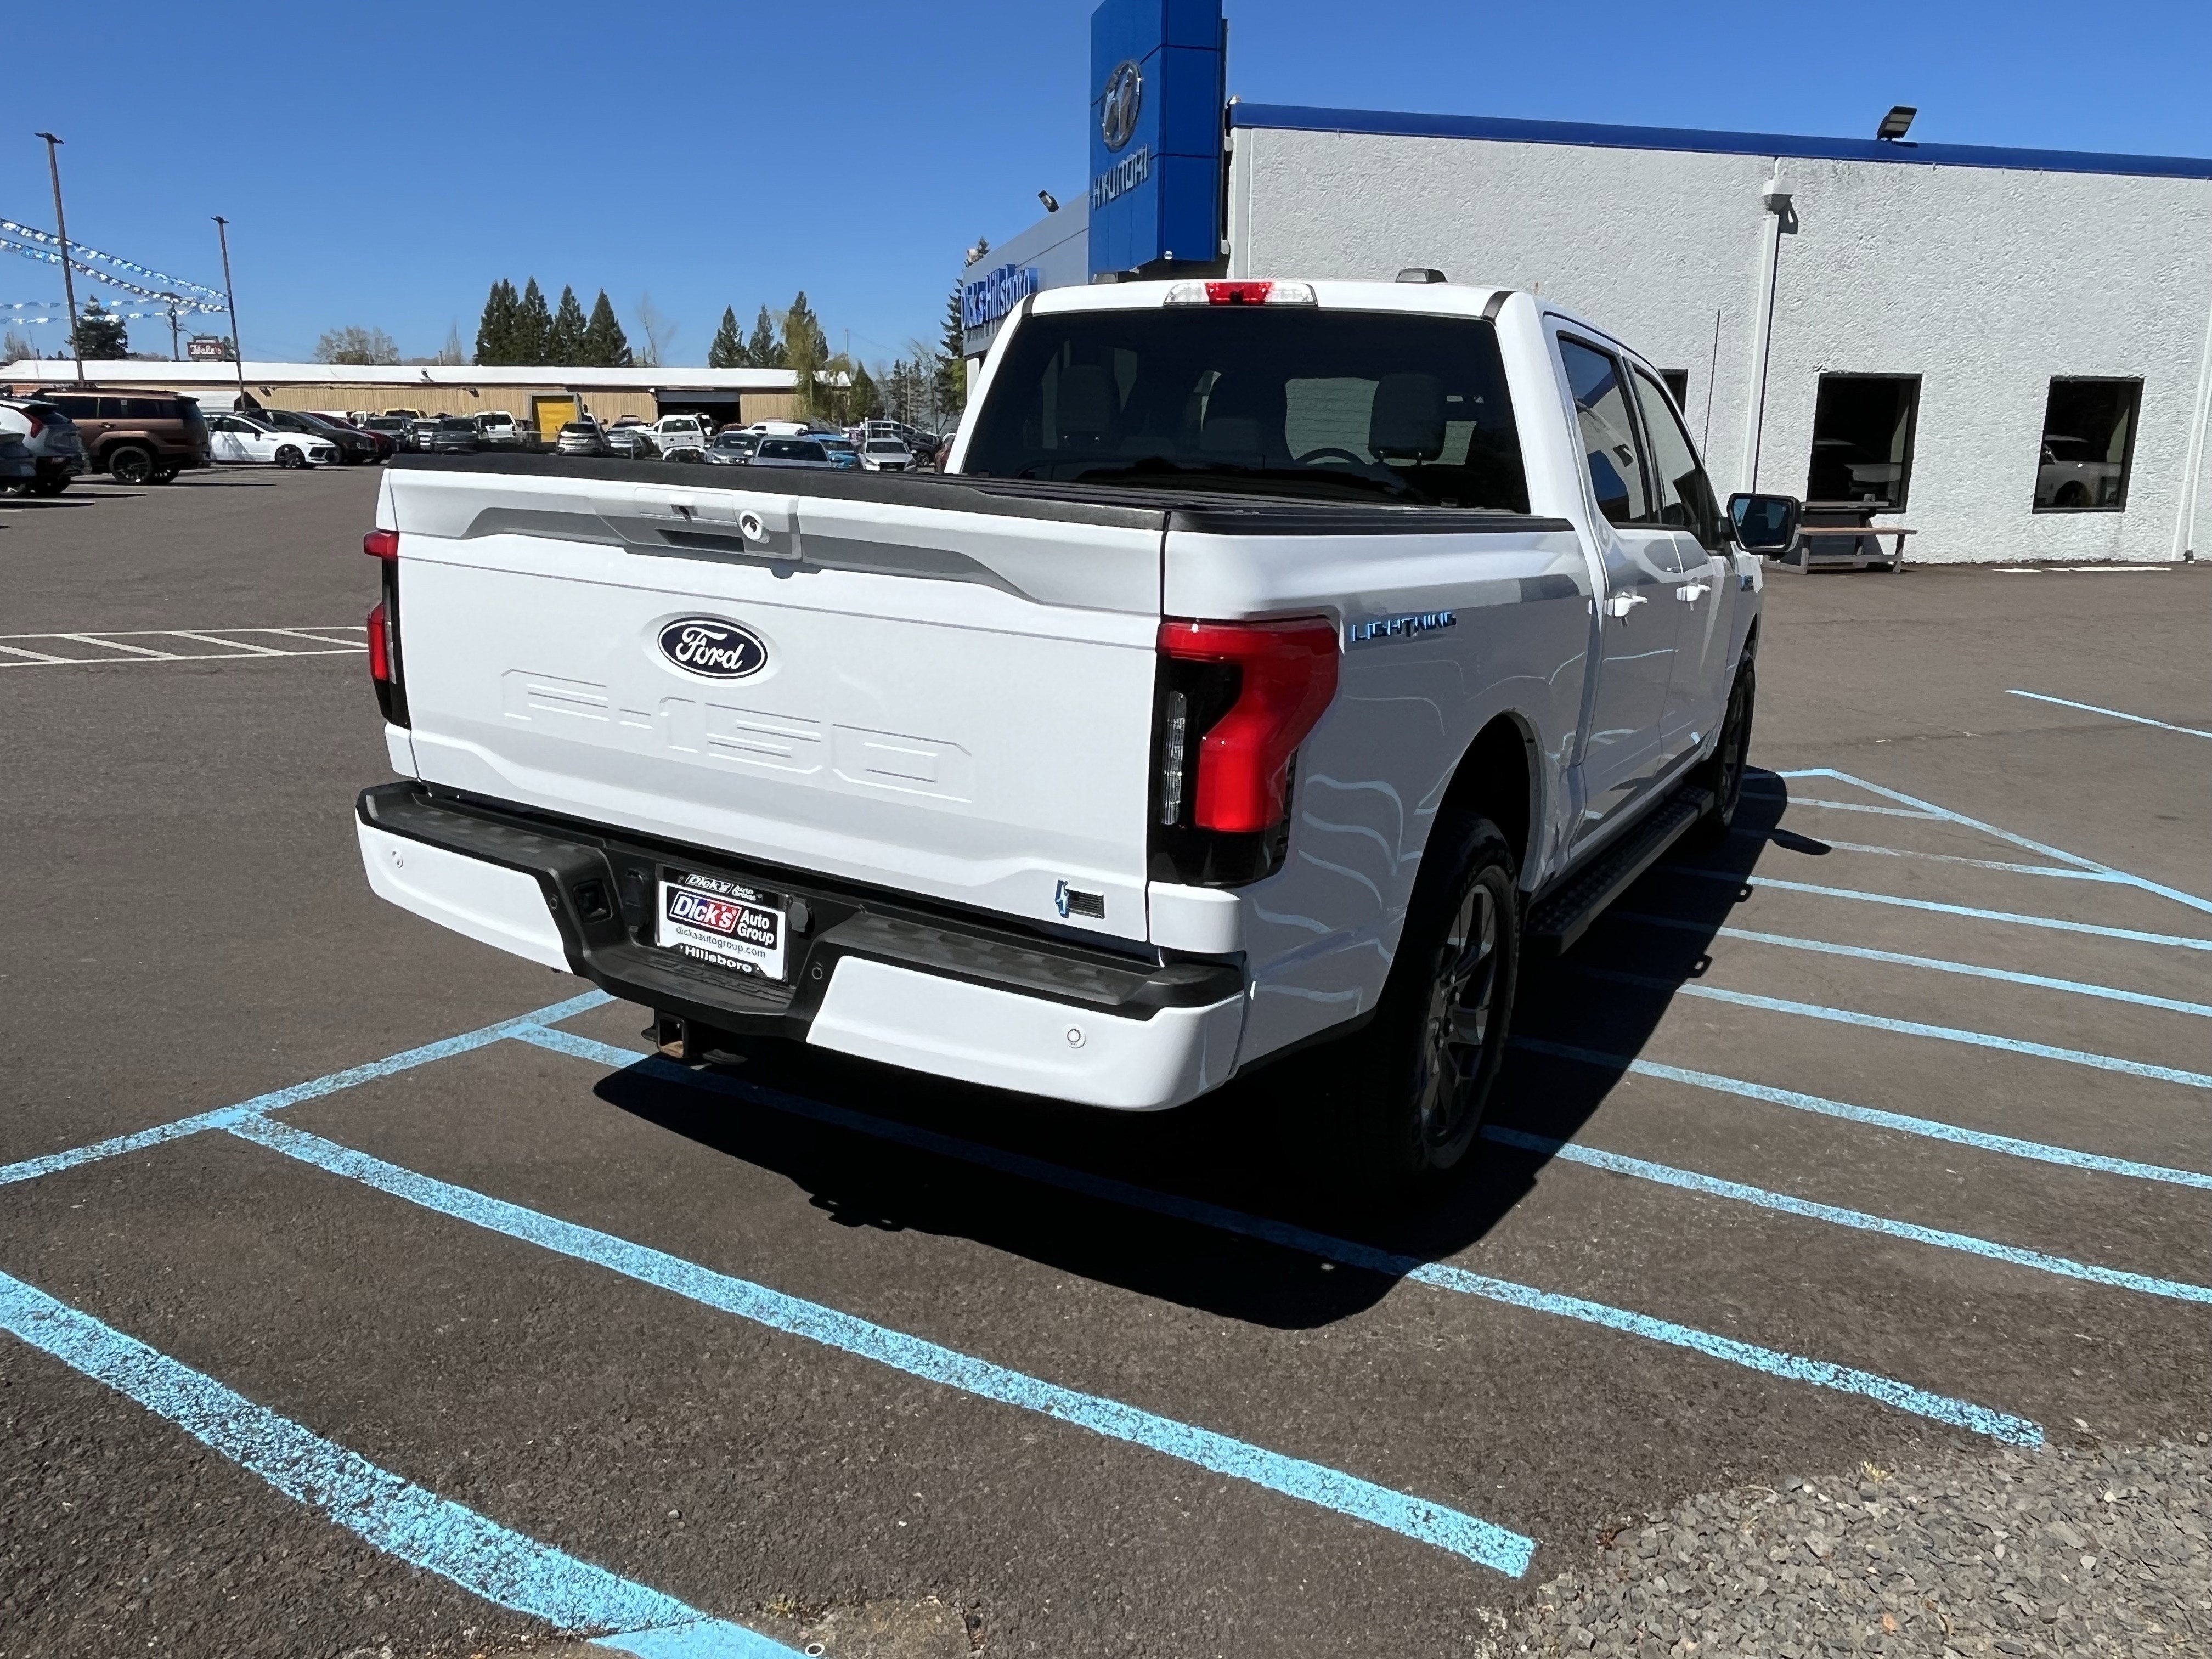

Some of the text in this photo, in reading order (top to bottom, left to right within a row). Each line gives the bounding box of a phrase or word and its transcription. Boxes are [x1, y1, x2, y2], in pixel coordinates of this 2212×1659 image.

[1352, 612, 1457, 641] LIGHTNING
[675, 627, 745, 670] Ford
[673, 895, 770, 929] Dick's Auto
[676, 926, 766, 958] dicksautogroup.com
[737, 922, 775, 946] Group
